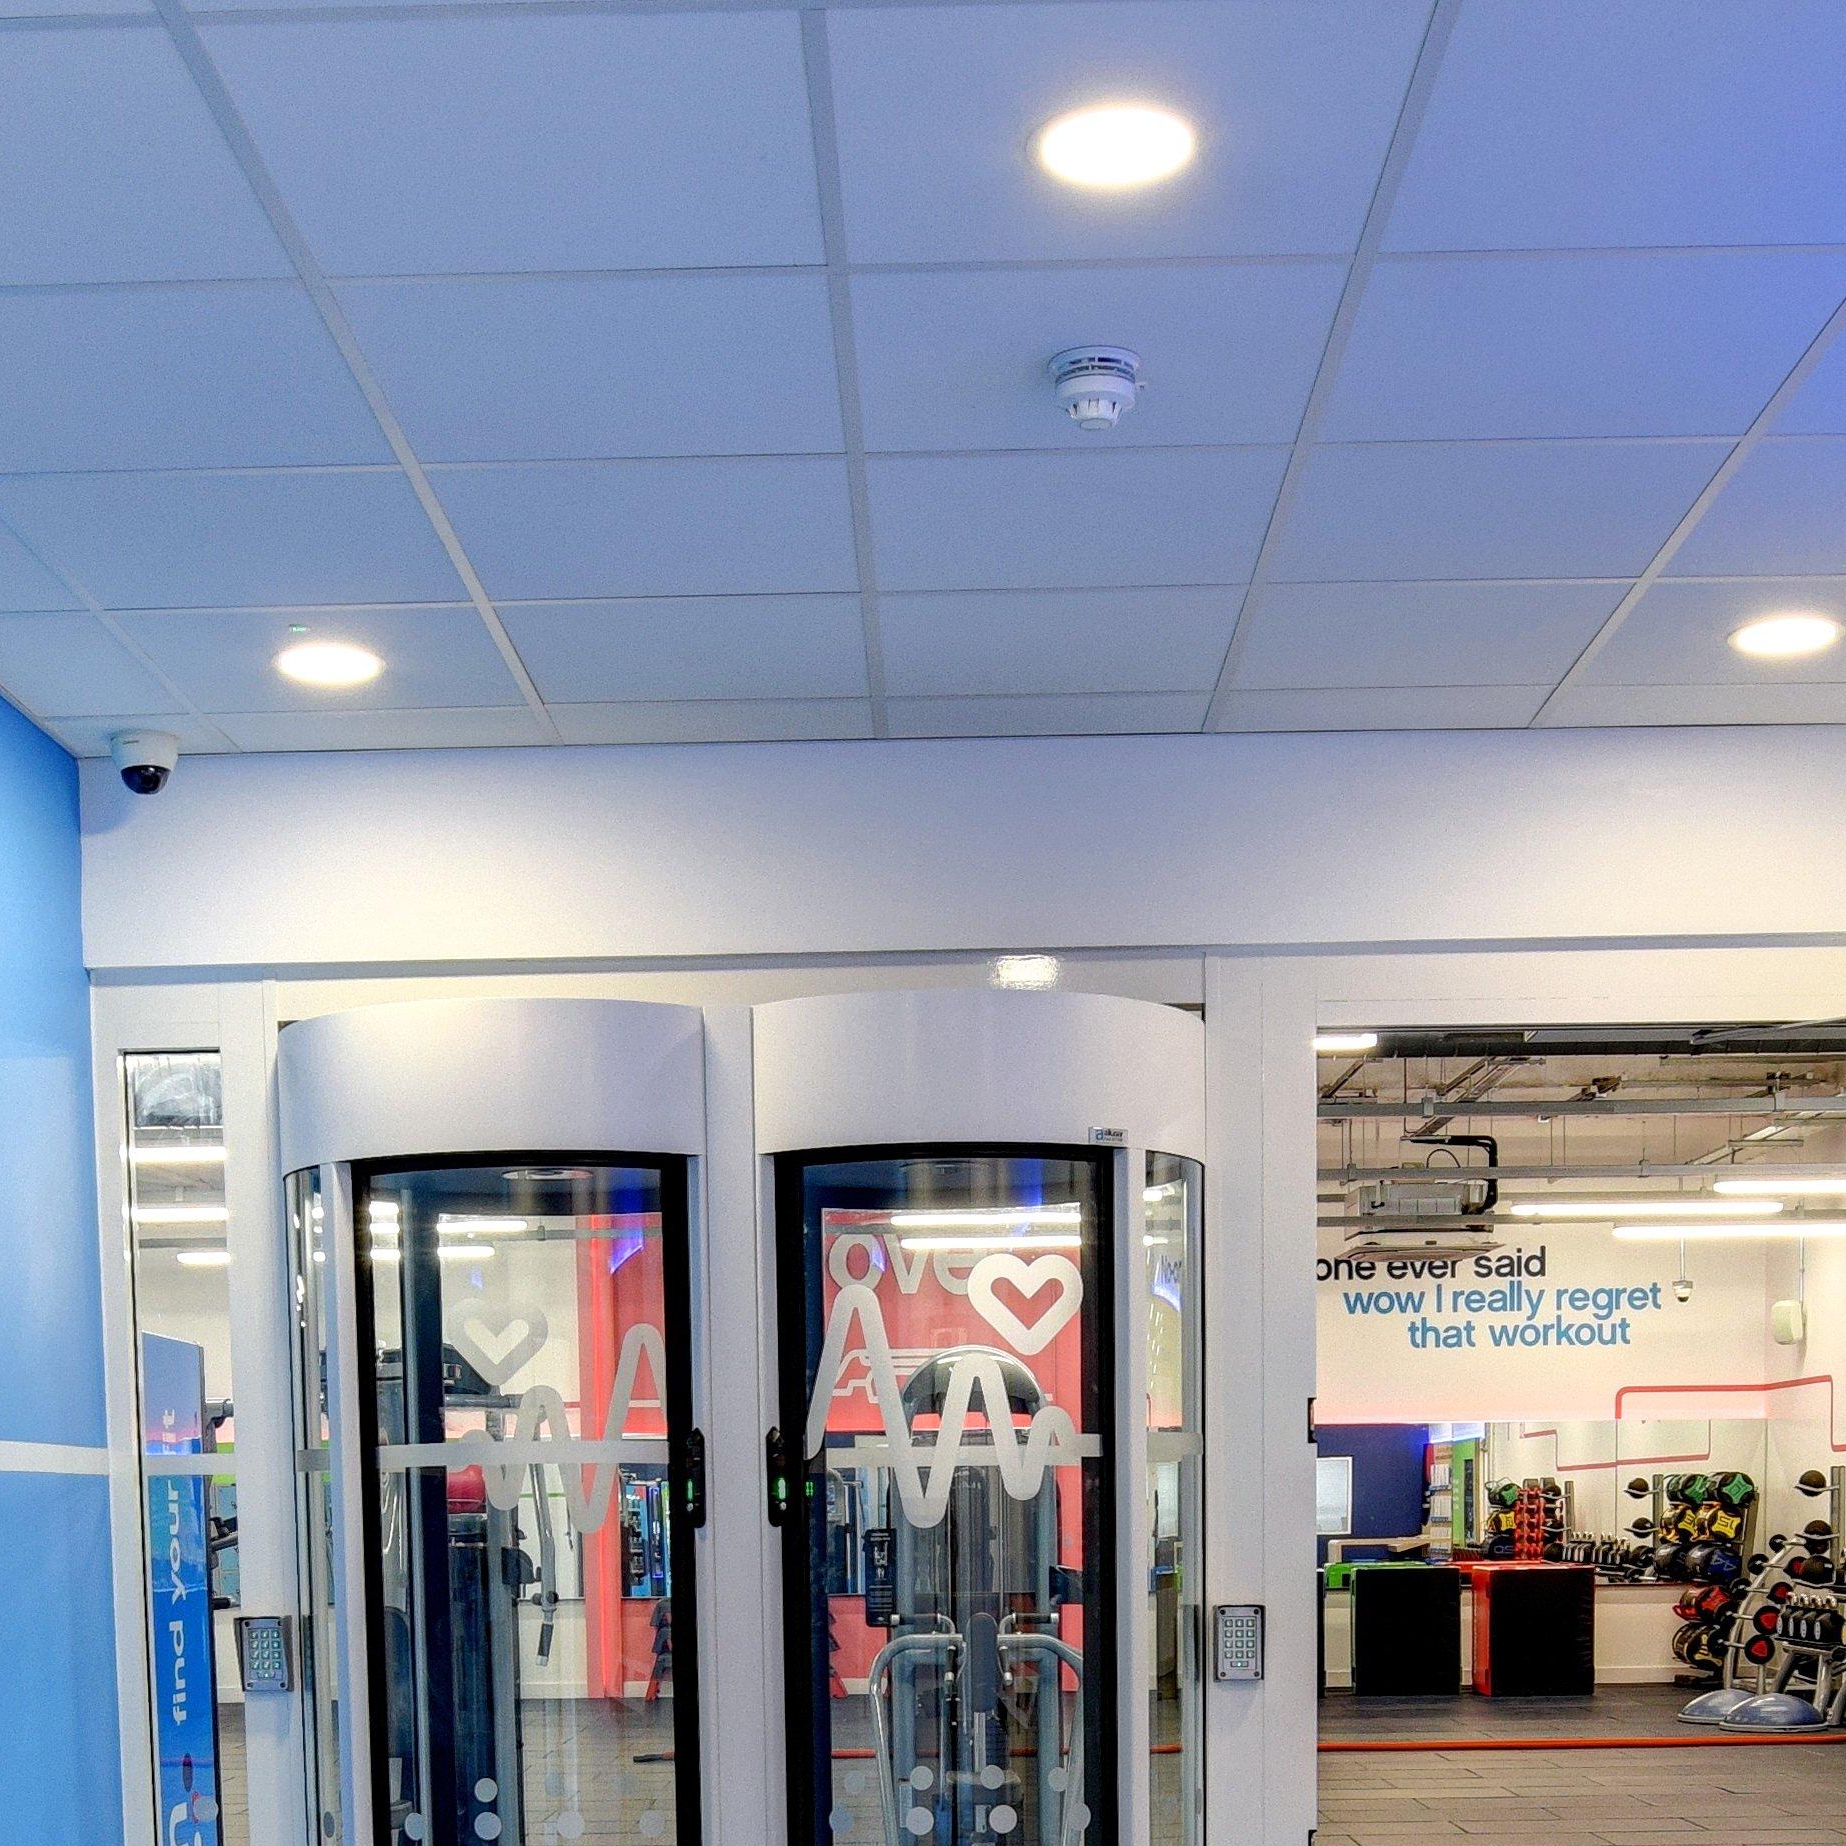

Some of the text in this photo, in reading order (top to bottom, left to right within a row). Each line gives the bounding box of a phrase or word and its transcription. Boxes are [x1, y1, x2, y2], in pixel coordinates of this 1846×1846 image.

[1387, 1258, 1458, 1280] ever
[1473, 1245, 1547, 1278] said
[1343, 1290, 1425, 1315] wow
[1452, 1280, 1545, 1322] really
[1556, 1283, 1662, 1320] regret
[1408, 1314, 1631, 1349] that workout
[168, 1480, 186, 1605] your
[172, 1620, 187, 1725] find
